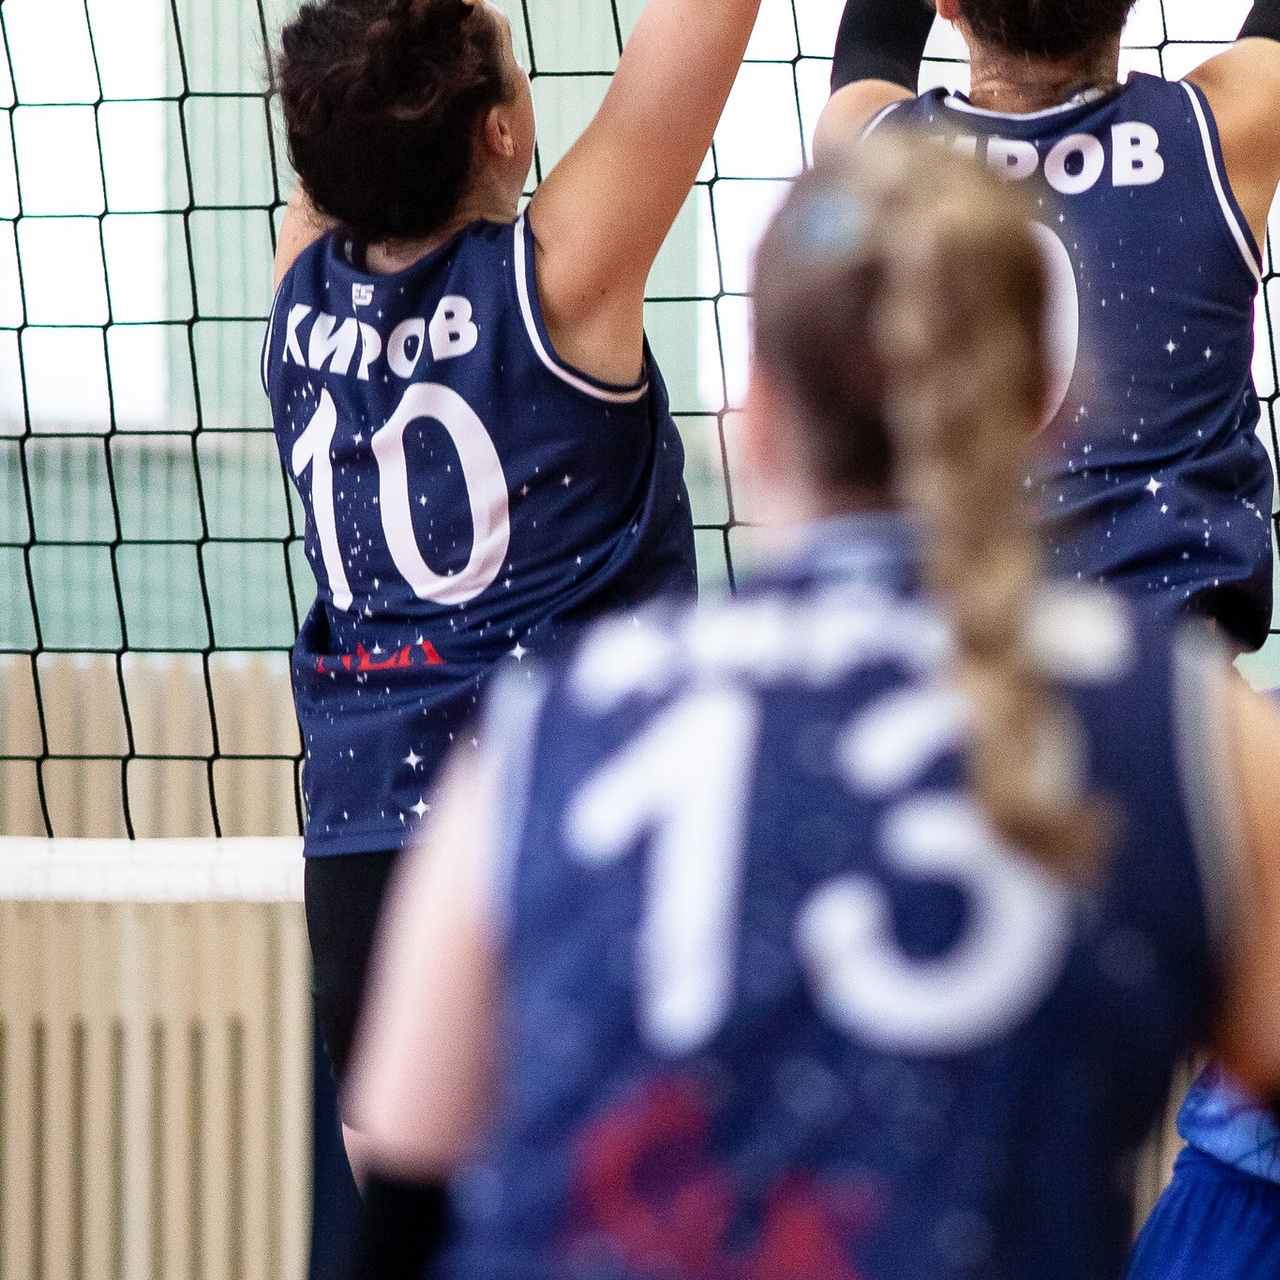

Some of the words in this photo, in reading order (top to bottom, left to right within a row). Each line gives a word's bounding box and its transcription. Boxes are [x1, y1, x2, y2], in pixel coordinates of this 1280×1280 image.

[930, 120, 1165, 194] РОВ
[282, 295, 479, 381] КИРОВ
[292, 382, 510, 612] 10
[562, 682, 1075, 1060] 13
